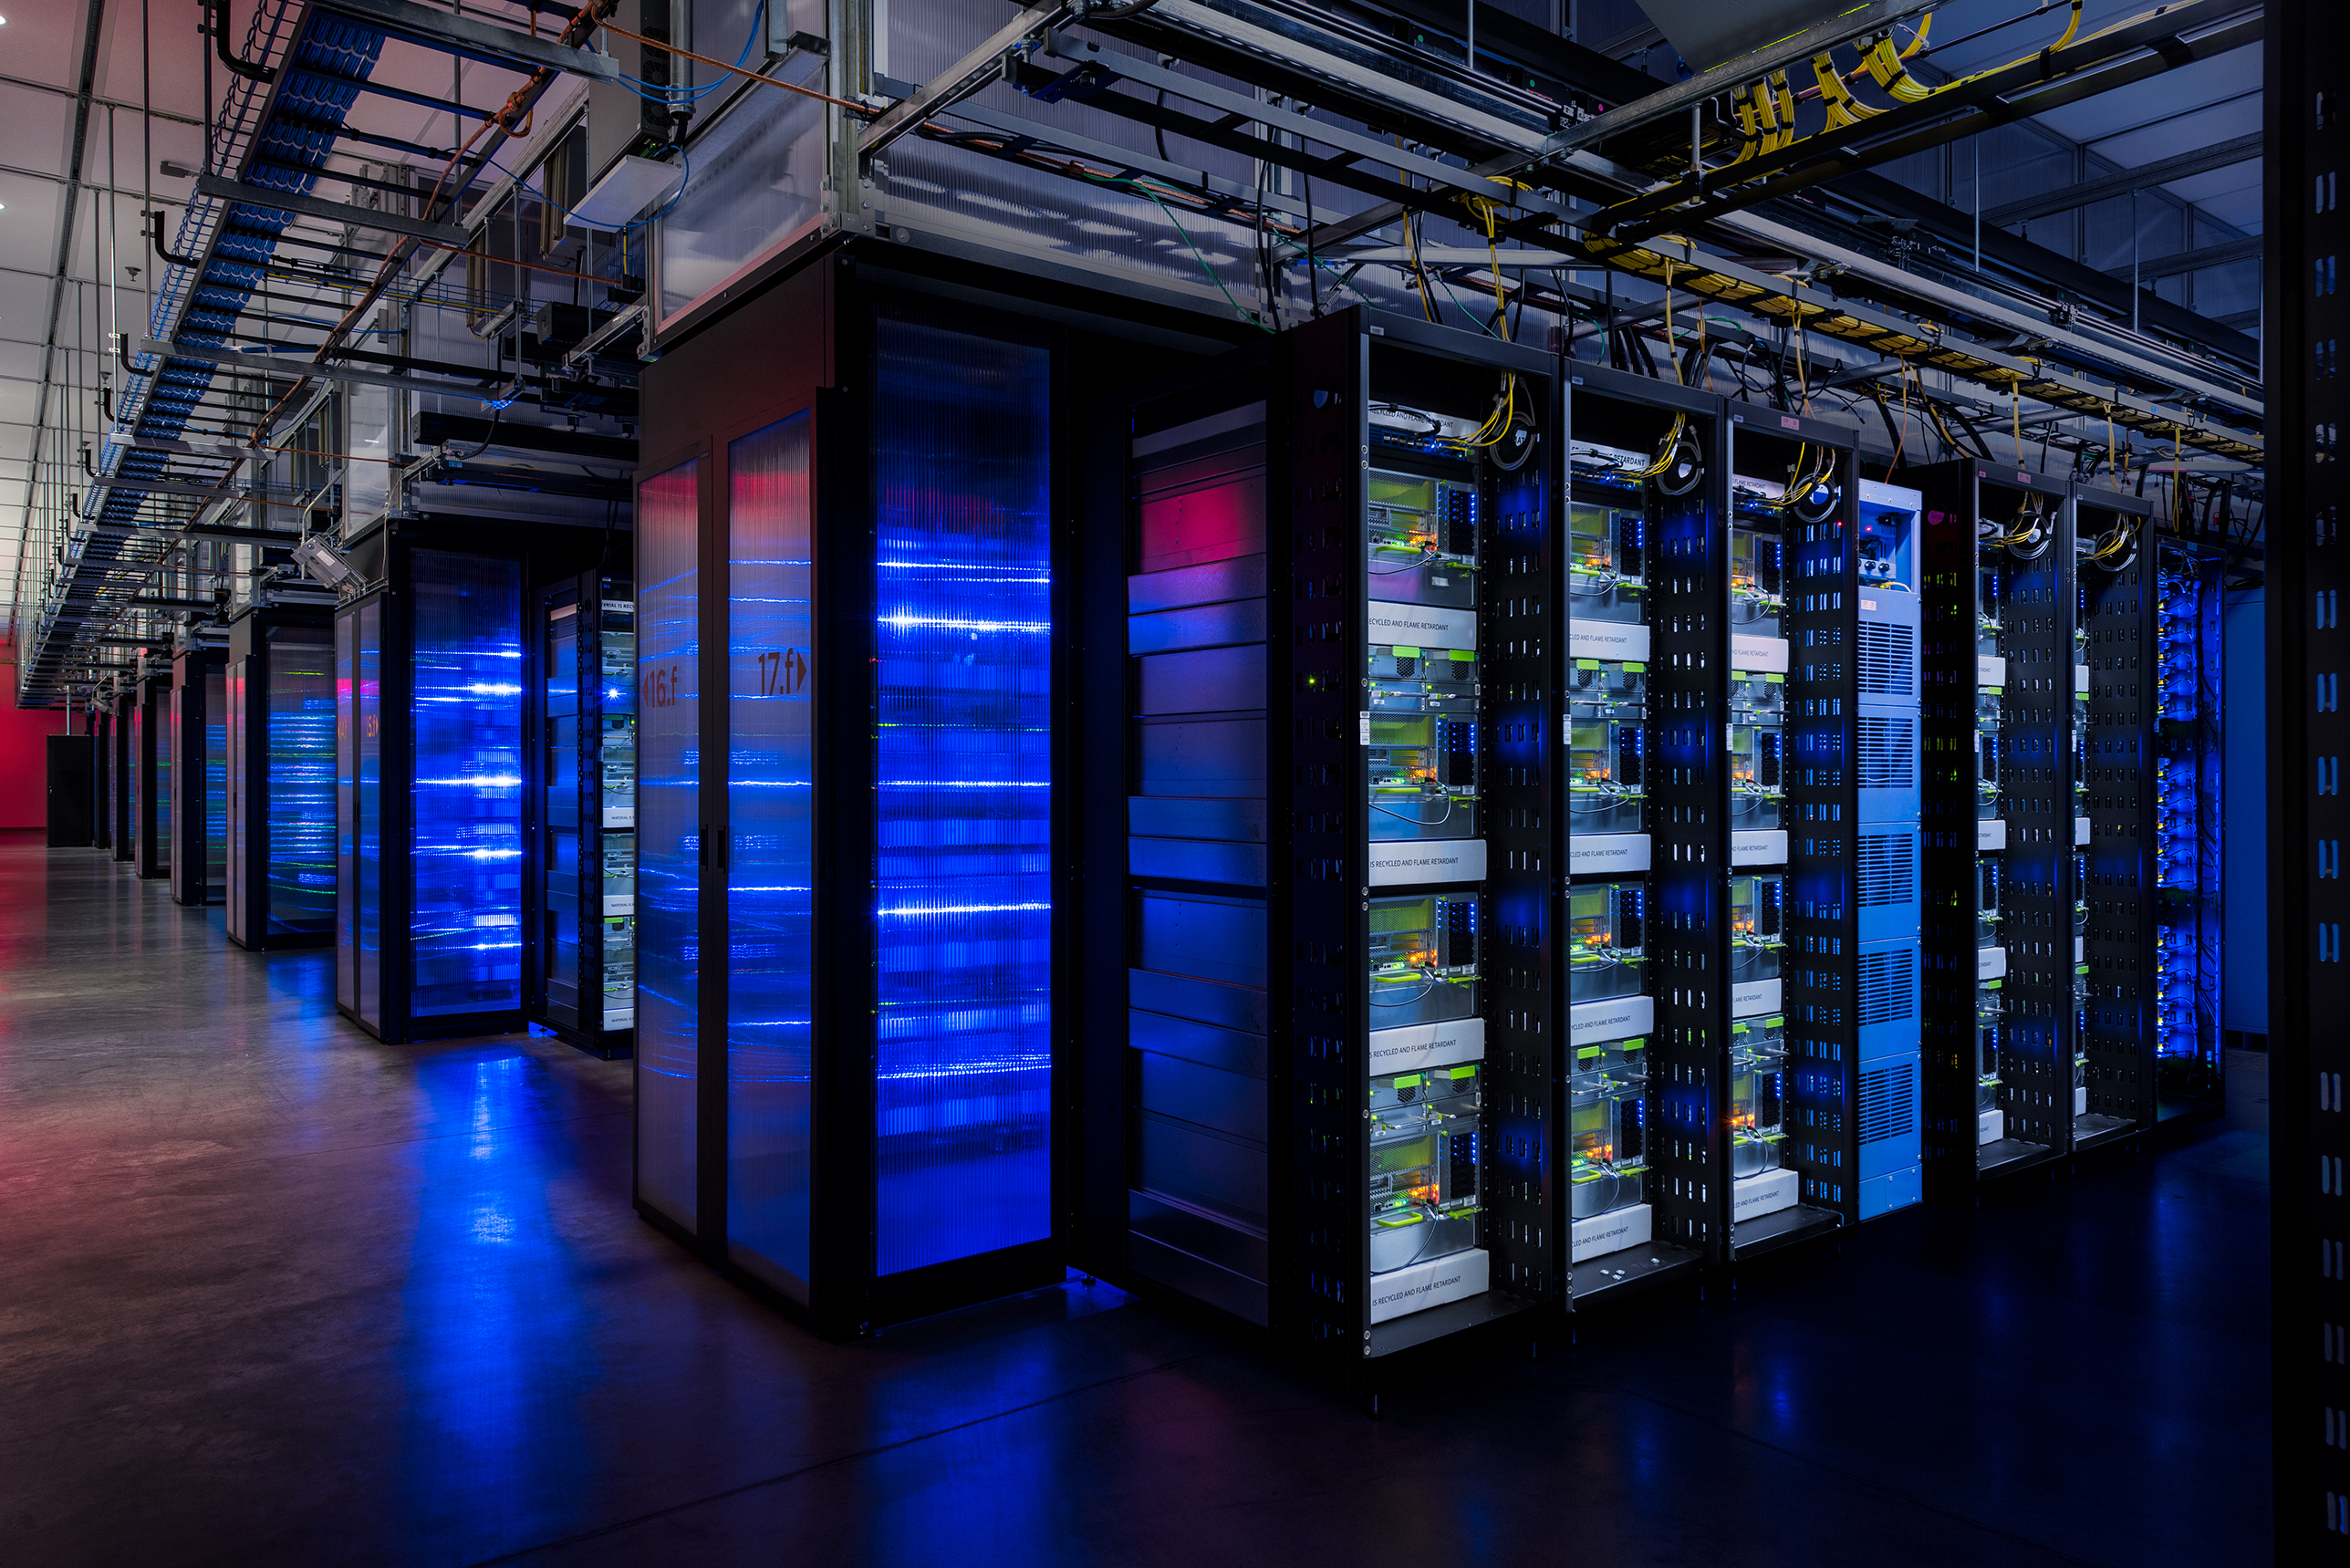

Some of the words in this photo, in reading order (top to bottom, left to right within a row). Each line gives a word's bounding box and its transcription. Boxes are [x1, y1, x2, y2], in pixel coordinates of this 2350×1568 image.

[758, 649, 794, 695] 17.f
[650, 665, 677, 708] 16.f
[1376, 859, 1400, 867] RECYCLED
[1608, 1015, 1630, 1023] RETARDANT
[1374, 1048, 1399, 1057] RECYCLED
[1411, 1044, 1428, 1052] FLAME
[1429, 1040, 1456, 1049] RETARDANT
[1761, 1190, 1779, 1200] RETARDANT
[1582, 1237, 1591, 1245] AND
[1592, 1233, 1605, 1241] FLAME
[1606, 1226, 1628, 1238] RETARDANT
[1378, 1292, 1403, 1304] RECYCLED
[1404, 1289, 1415, 1297] AND
[1416, 1284, 1432, 1294] FLAME
[1433, 1276, 1461, 1289] RETARDANT
